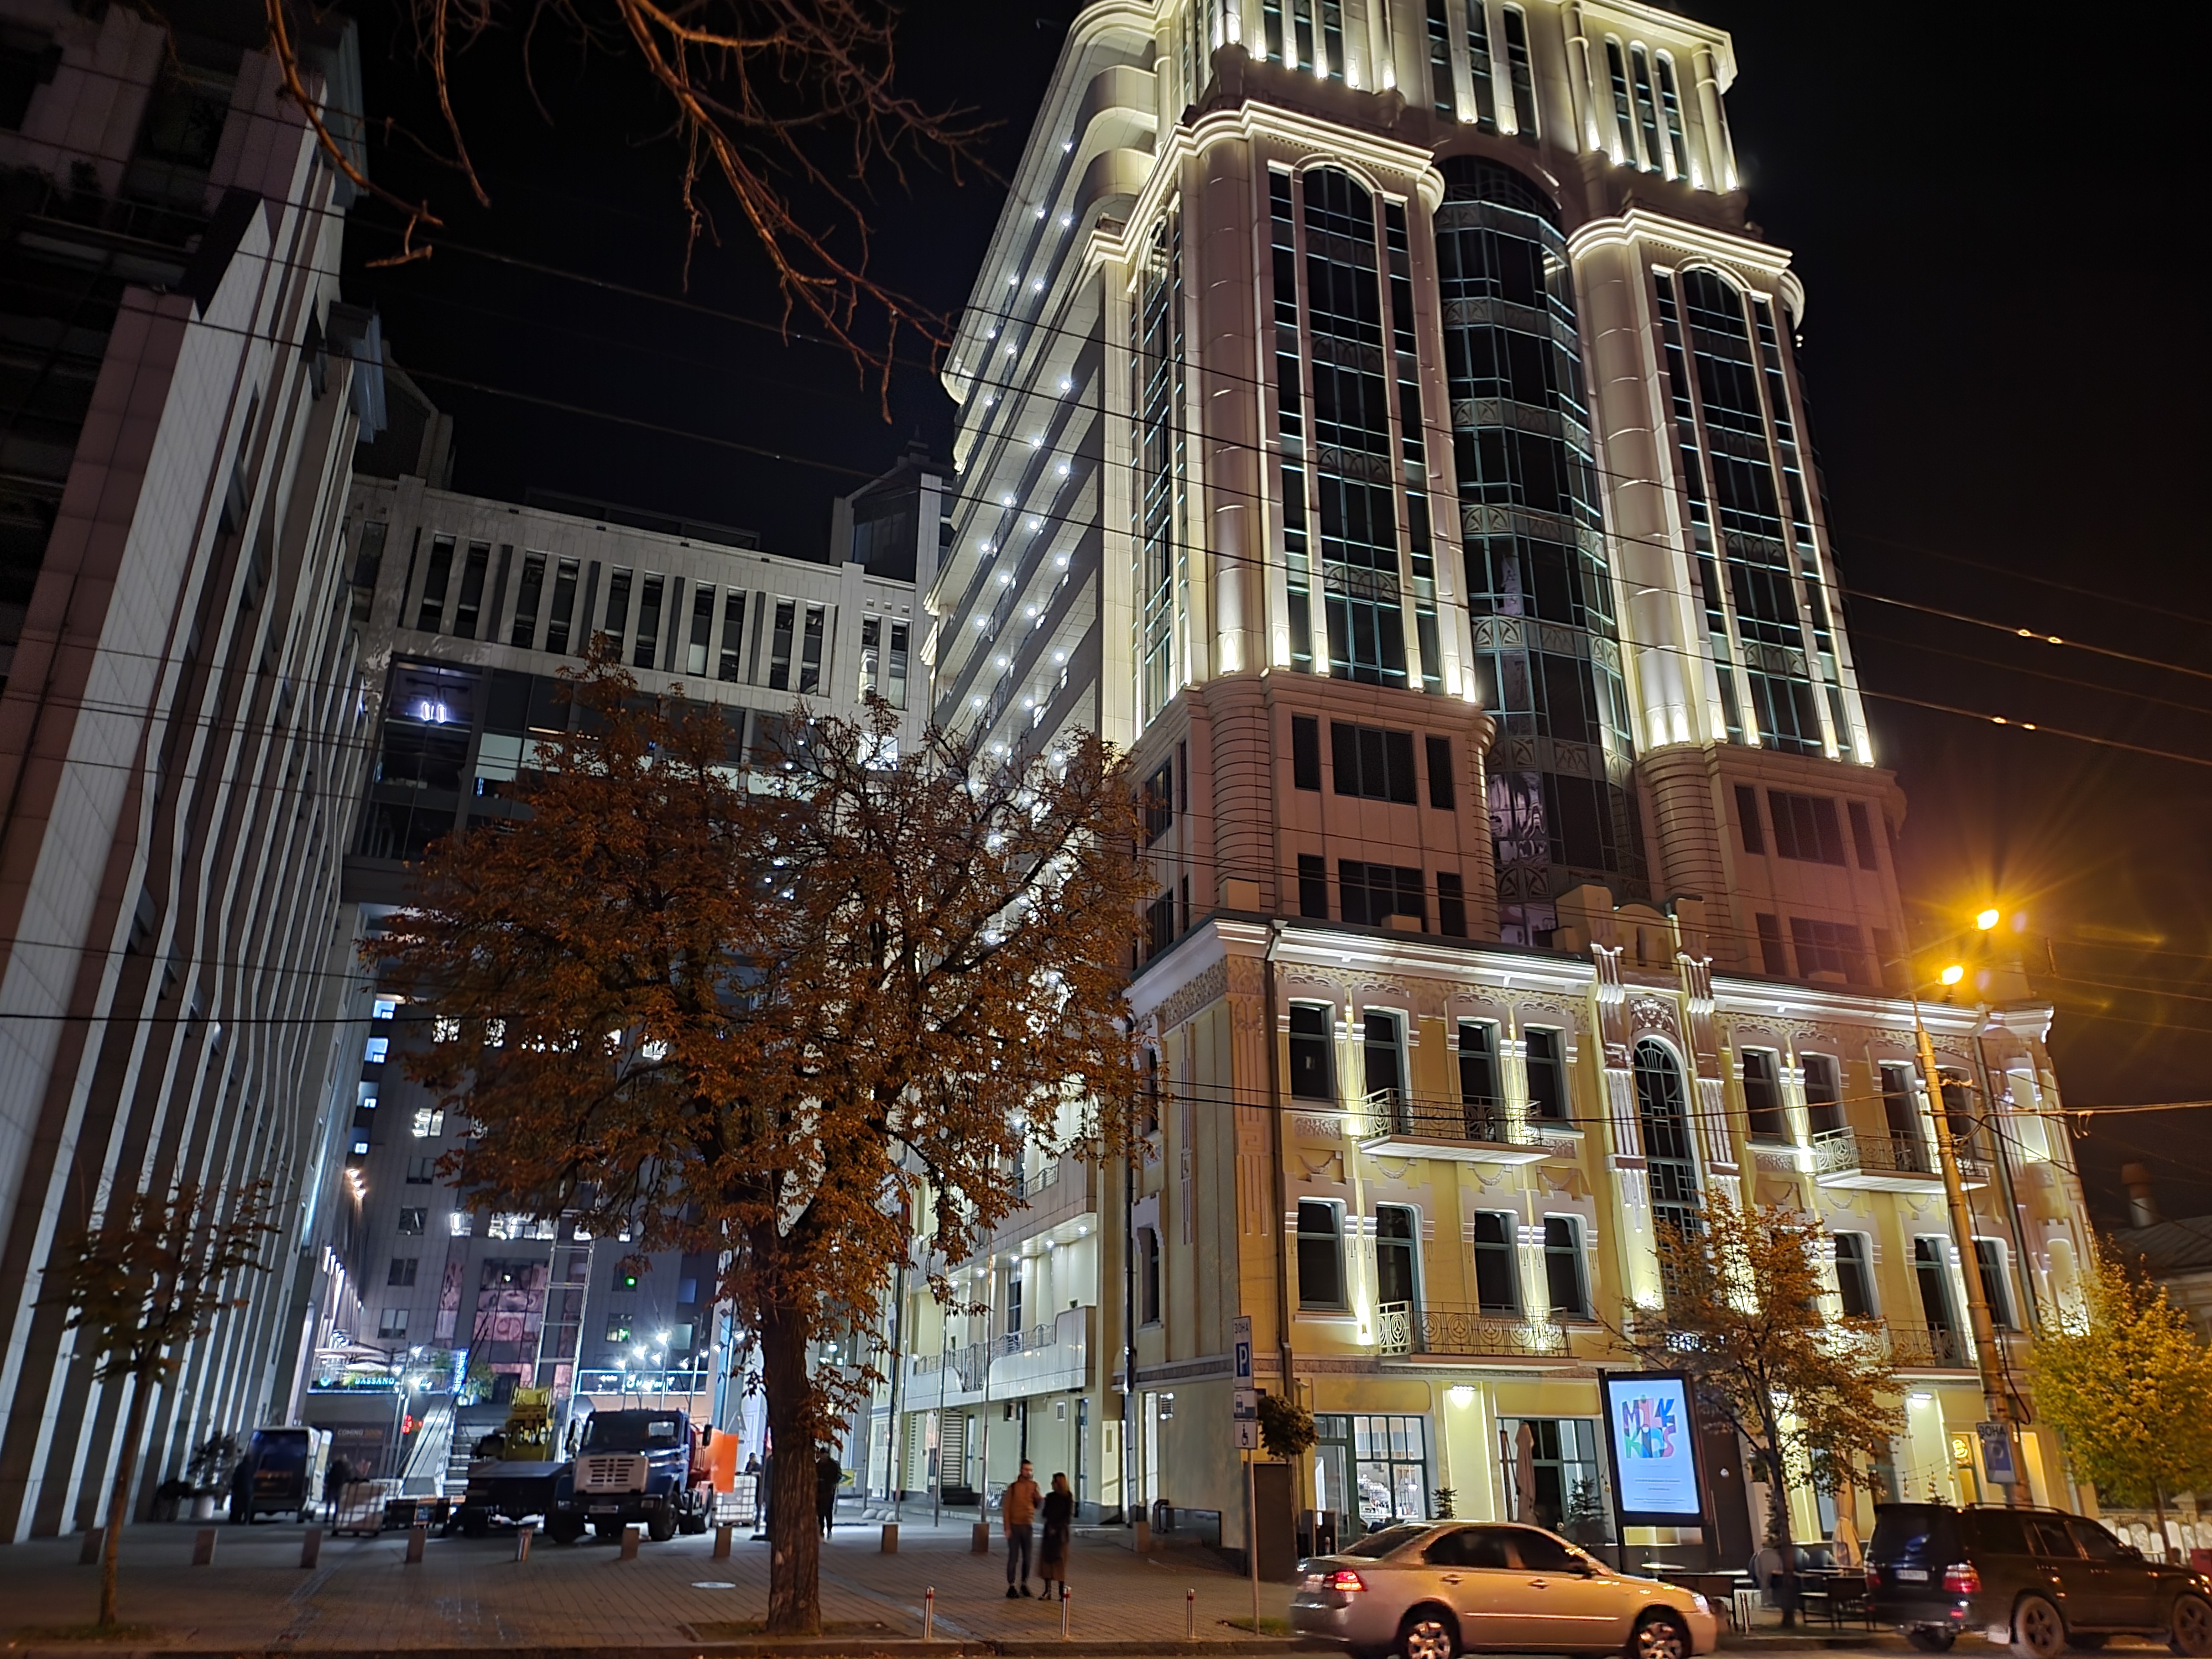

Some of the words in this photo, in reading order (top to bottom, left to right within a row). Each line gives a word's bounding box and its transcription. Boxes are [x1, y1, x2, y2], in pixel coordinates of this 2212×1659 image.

[1234, 1322, 1249, 1333] ЗОНА
[1239, 1345, 1248, 1374] P
[354, 1376, 395, 1385] BASSANO
[1979, 1425, 2006, 1437] ЗОНА
[1624, 1423, 1677, 1458] KIDS
[1987, 1443, 2004, 1467] P
